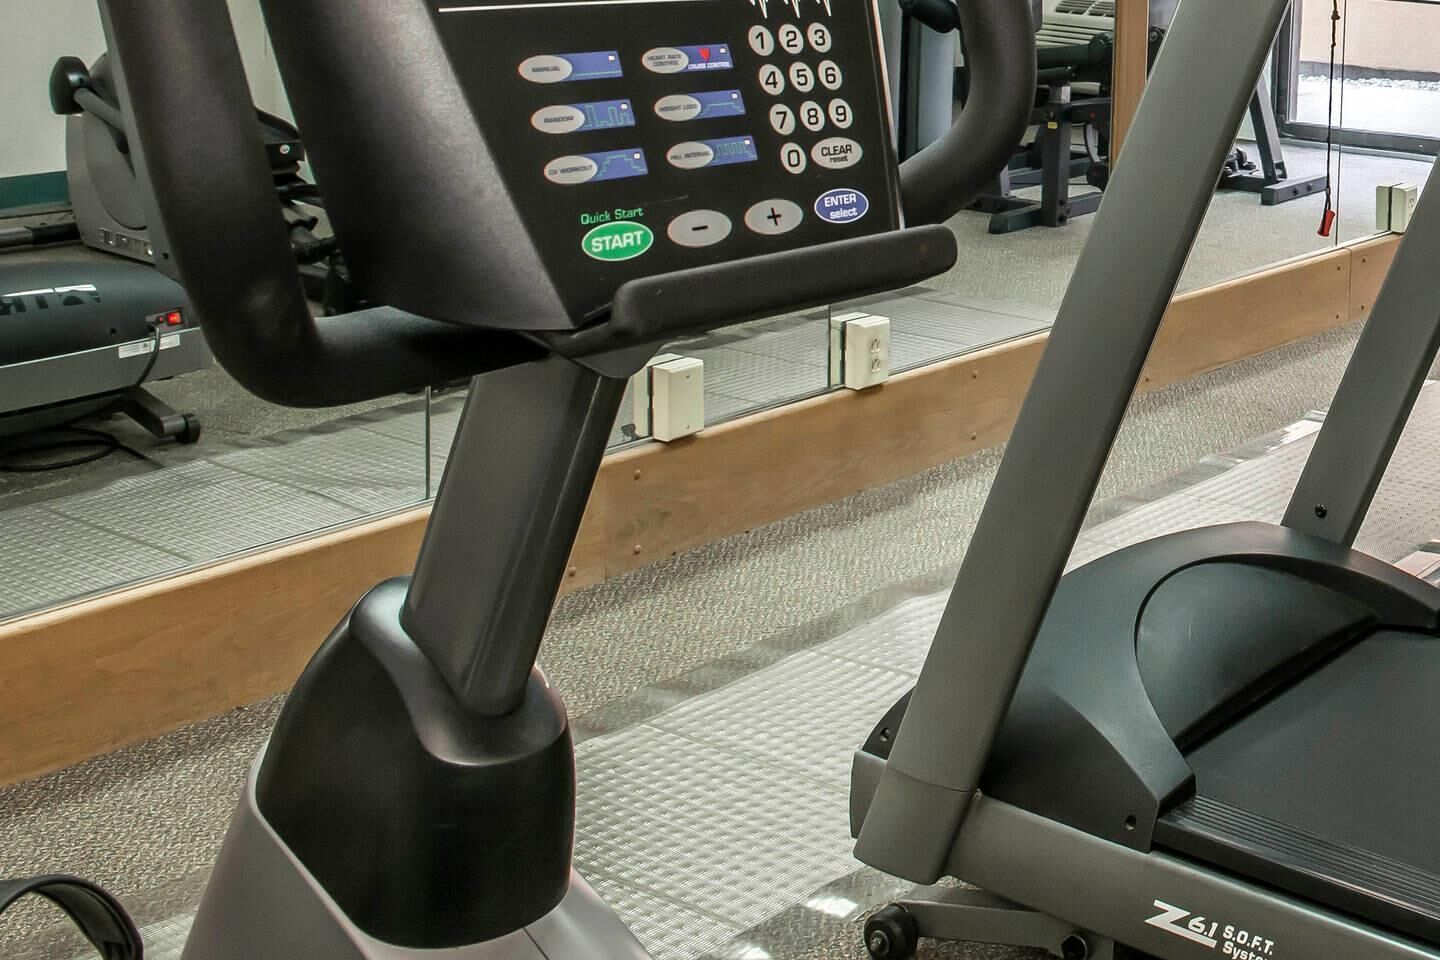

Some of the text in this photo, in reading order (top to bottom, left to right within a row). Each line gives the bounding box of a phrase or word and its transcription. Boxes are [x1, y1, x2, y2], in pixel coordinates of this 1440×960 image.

[755, 29, 826, 50] 1 2 3
[765, 66, 836, 89] 4 5 6
[775, 105, 847, 129] 7 8 9
[821, 144, 853, 157] CLEAR
[830, 155, 849, 163] reset
[824, 193, 857, 208] ENTER
[581, 207, 644, 225] Quick Start
[830, 206, 858, 220] select
[591, 230, 644, 252] START
[1222, 924, 1274, 956] S.O.F.T.
[1222, 941, 1267, 960] Syst
